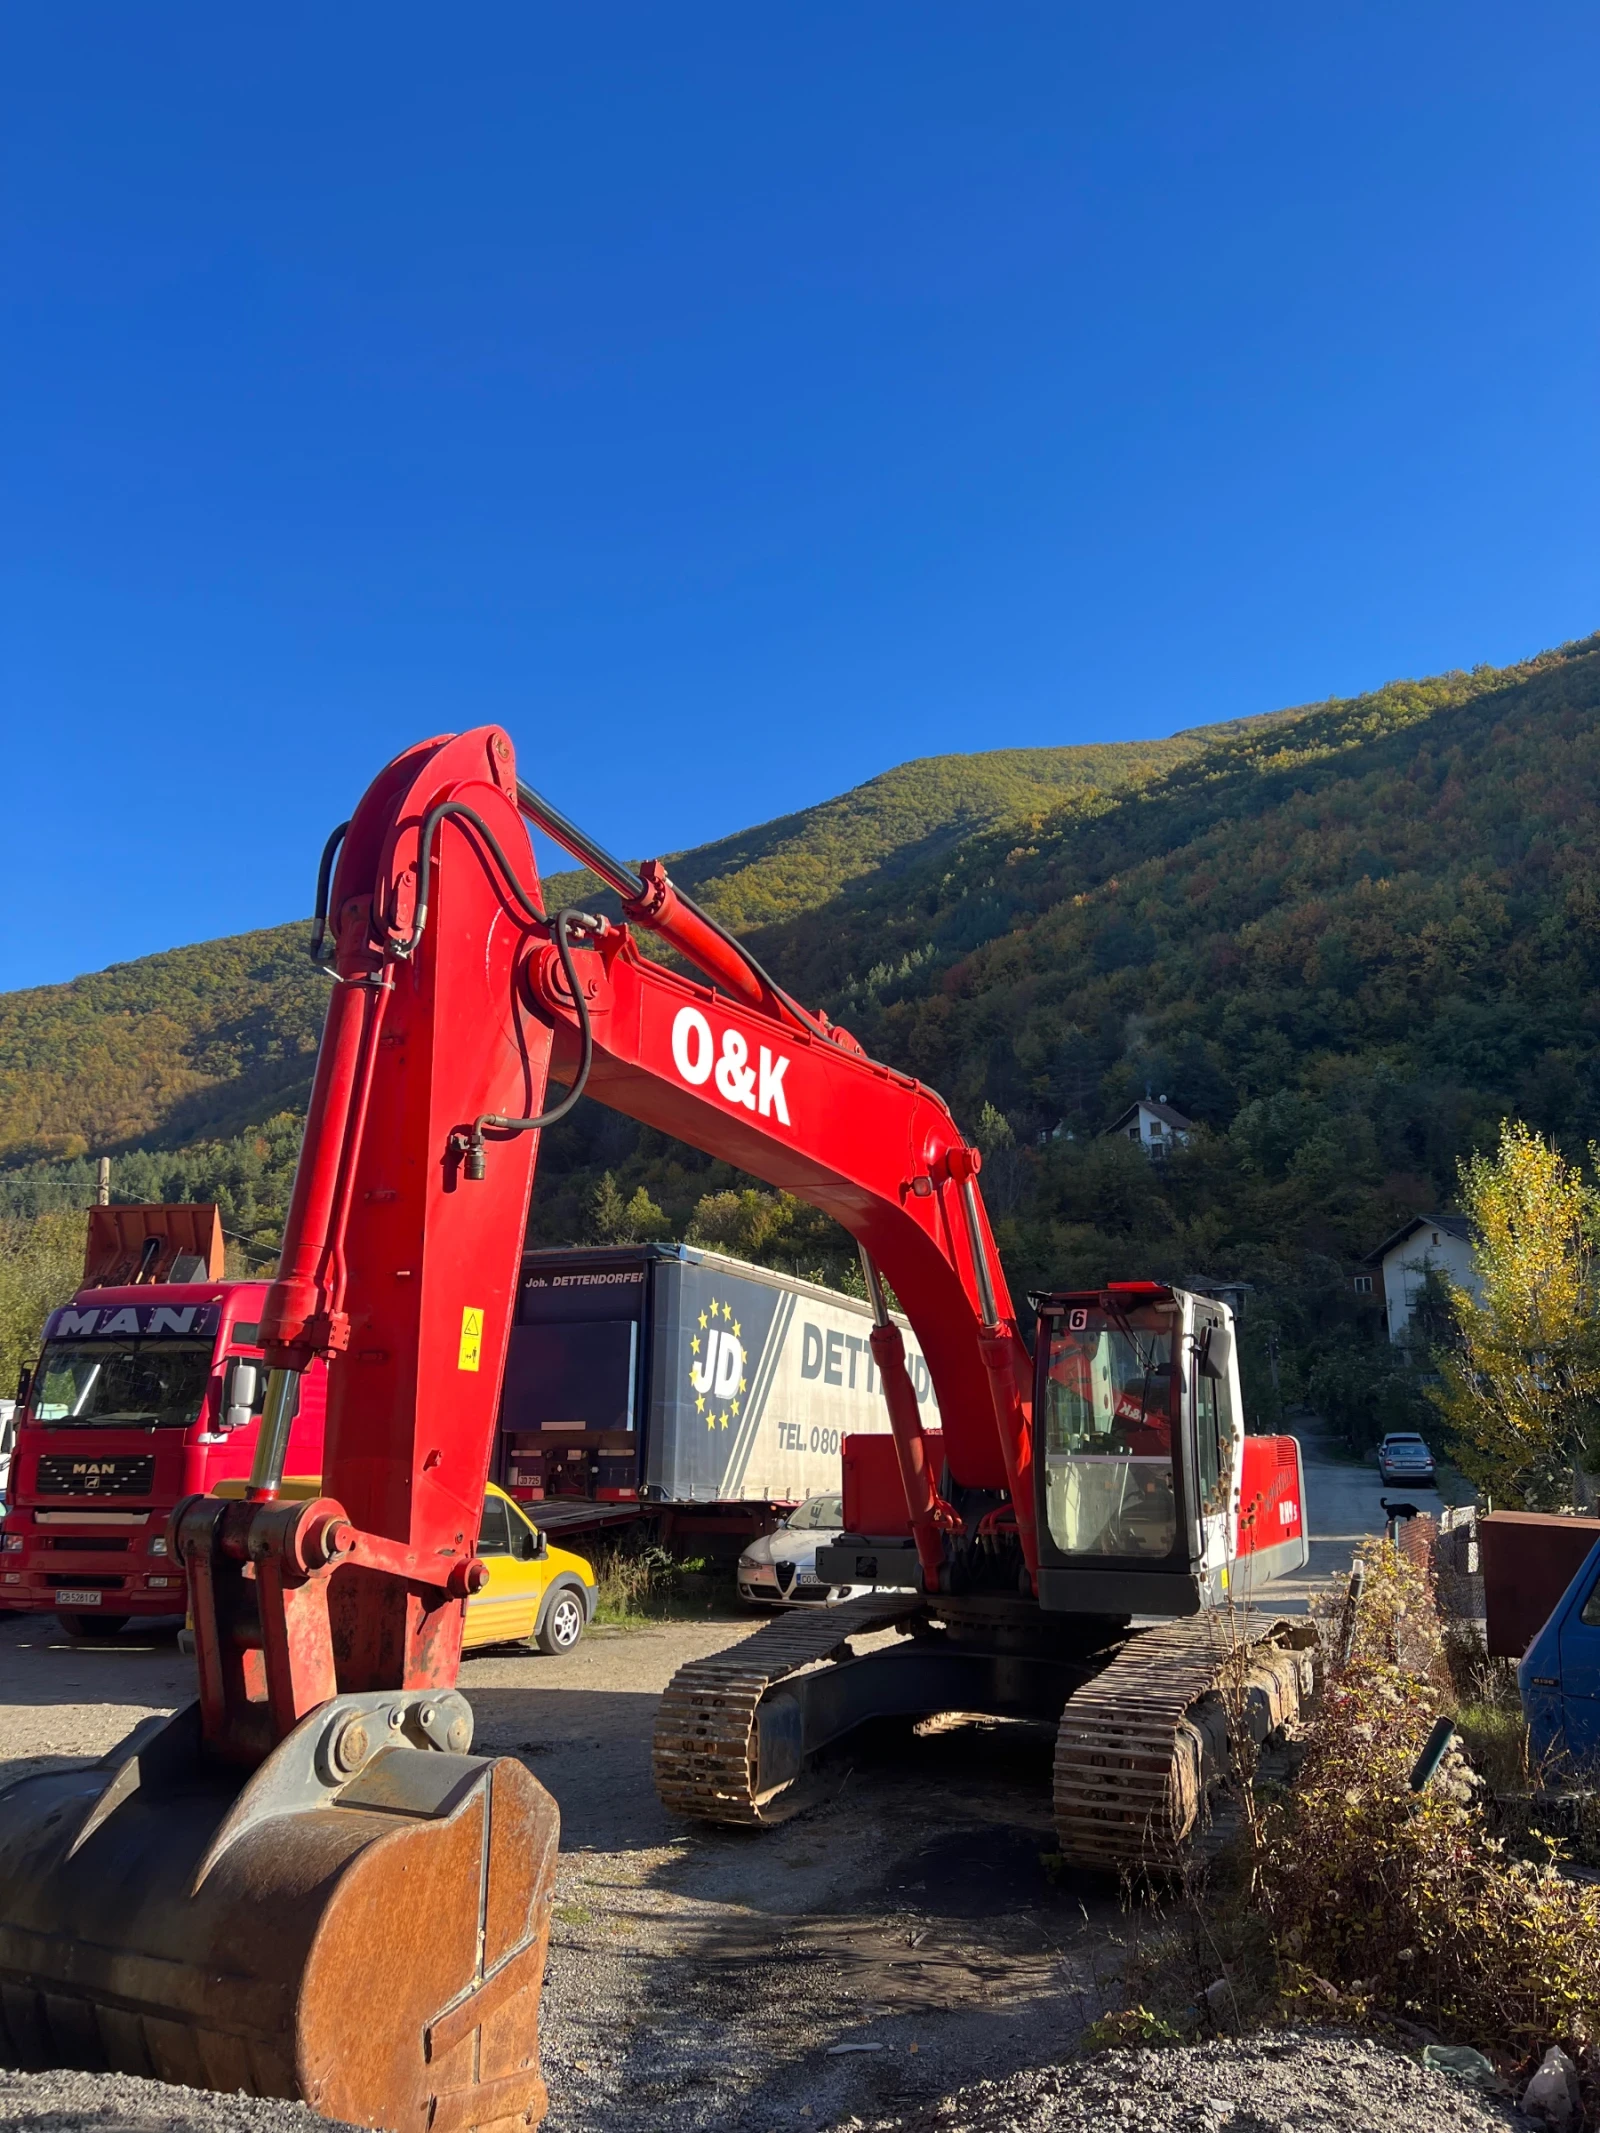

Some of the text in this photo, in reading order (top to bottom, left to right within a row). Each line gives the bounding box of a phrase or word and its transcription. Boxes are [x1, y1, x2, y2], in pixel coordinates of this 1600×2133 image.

[672, 1006, 791, 1126] O&K
[525, 1278, 548, 1288] Joh.
[56, 1307, 197, 1337] MAN
[1071, 1311, 1084, 1328] 6
[692, 1328, 743, 1400] JD
[801, 1322, 938, 1408] DETTD
[778, 1421, 807, 1451] TEL.
[73, 1464, 115, 1474] MAN
